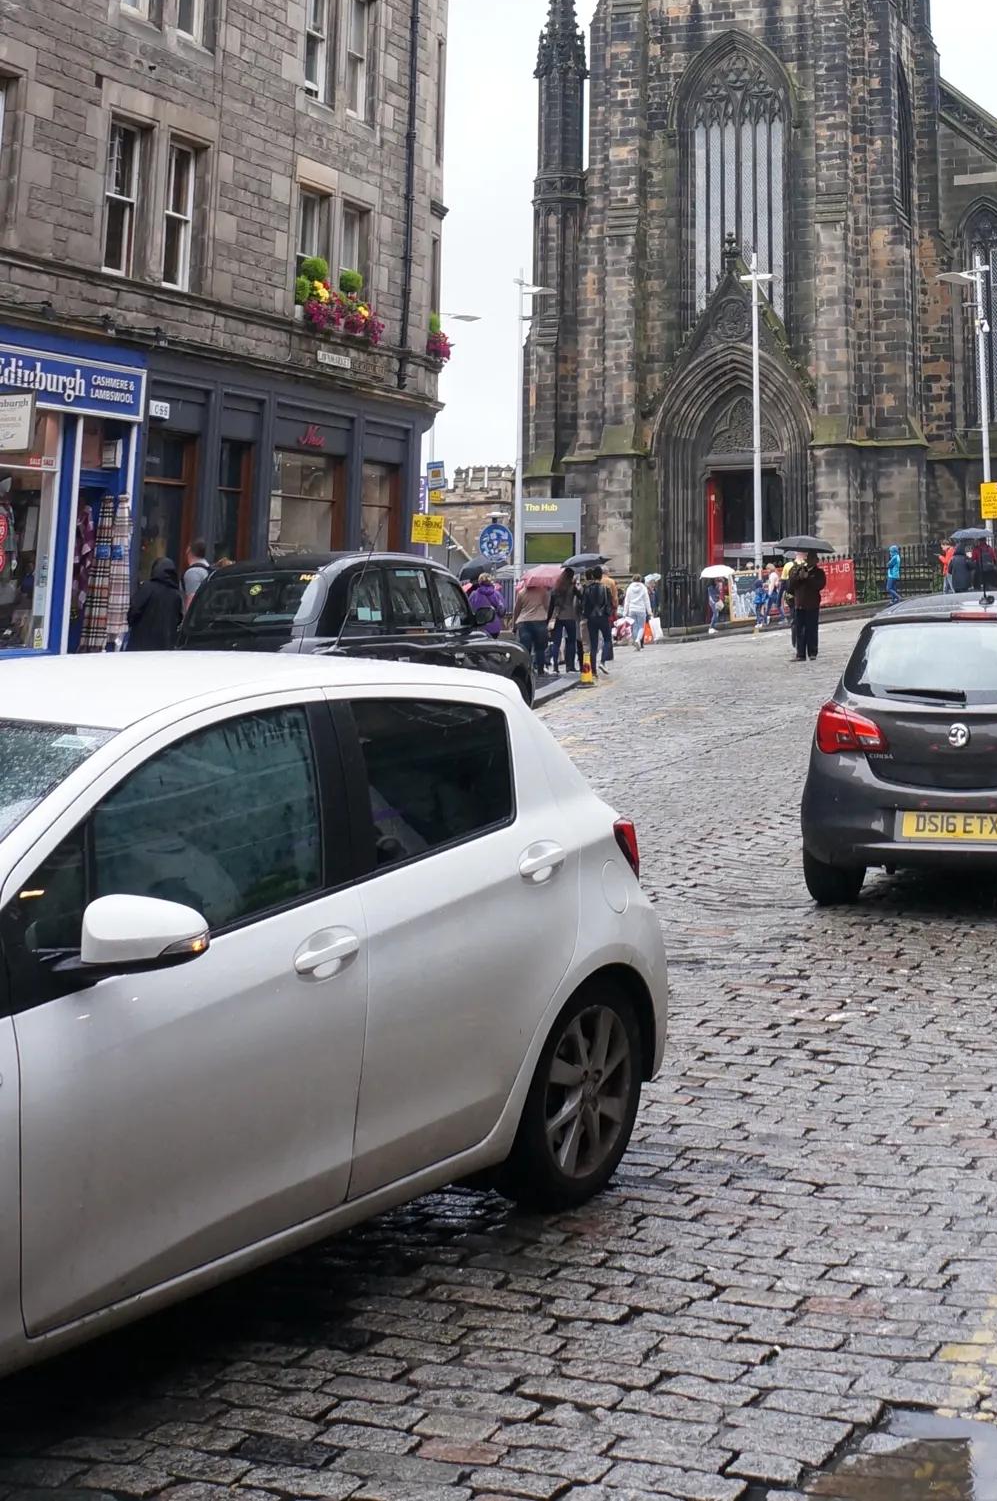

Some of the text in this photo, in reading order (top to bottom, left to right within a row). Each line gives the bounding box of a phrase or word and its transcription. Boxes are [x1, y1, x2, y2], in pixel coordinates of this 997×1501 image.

[0, 357, 86, 402] Edinburgh
[91, 374, 135, 391] CASHMERE &
[90, 388, 134, 405] LAMBSWOOL
[524, 503, 558, 511] The Hub
[830, 562, 850, 574] HUB
[915, 813, 957, 833] DS16
